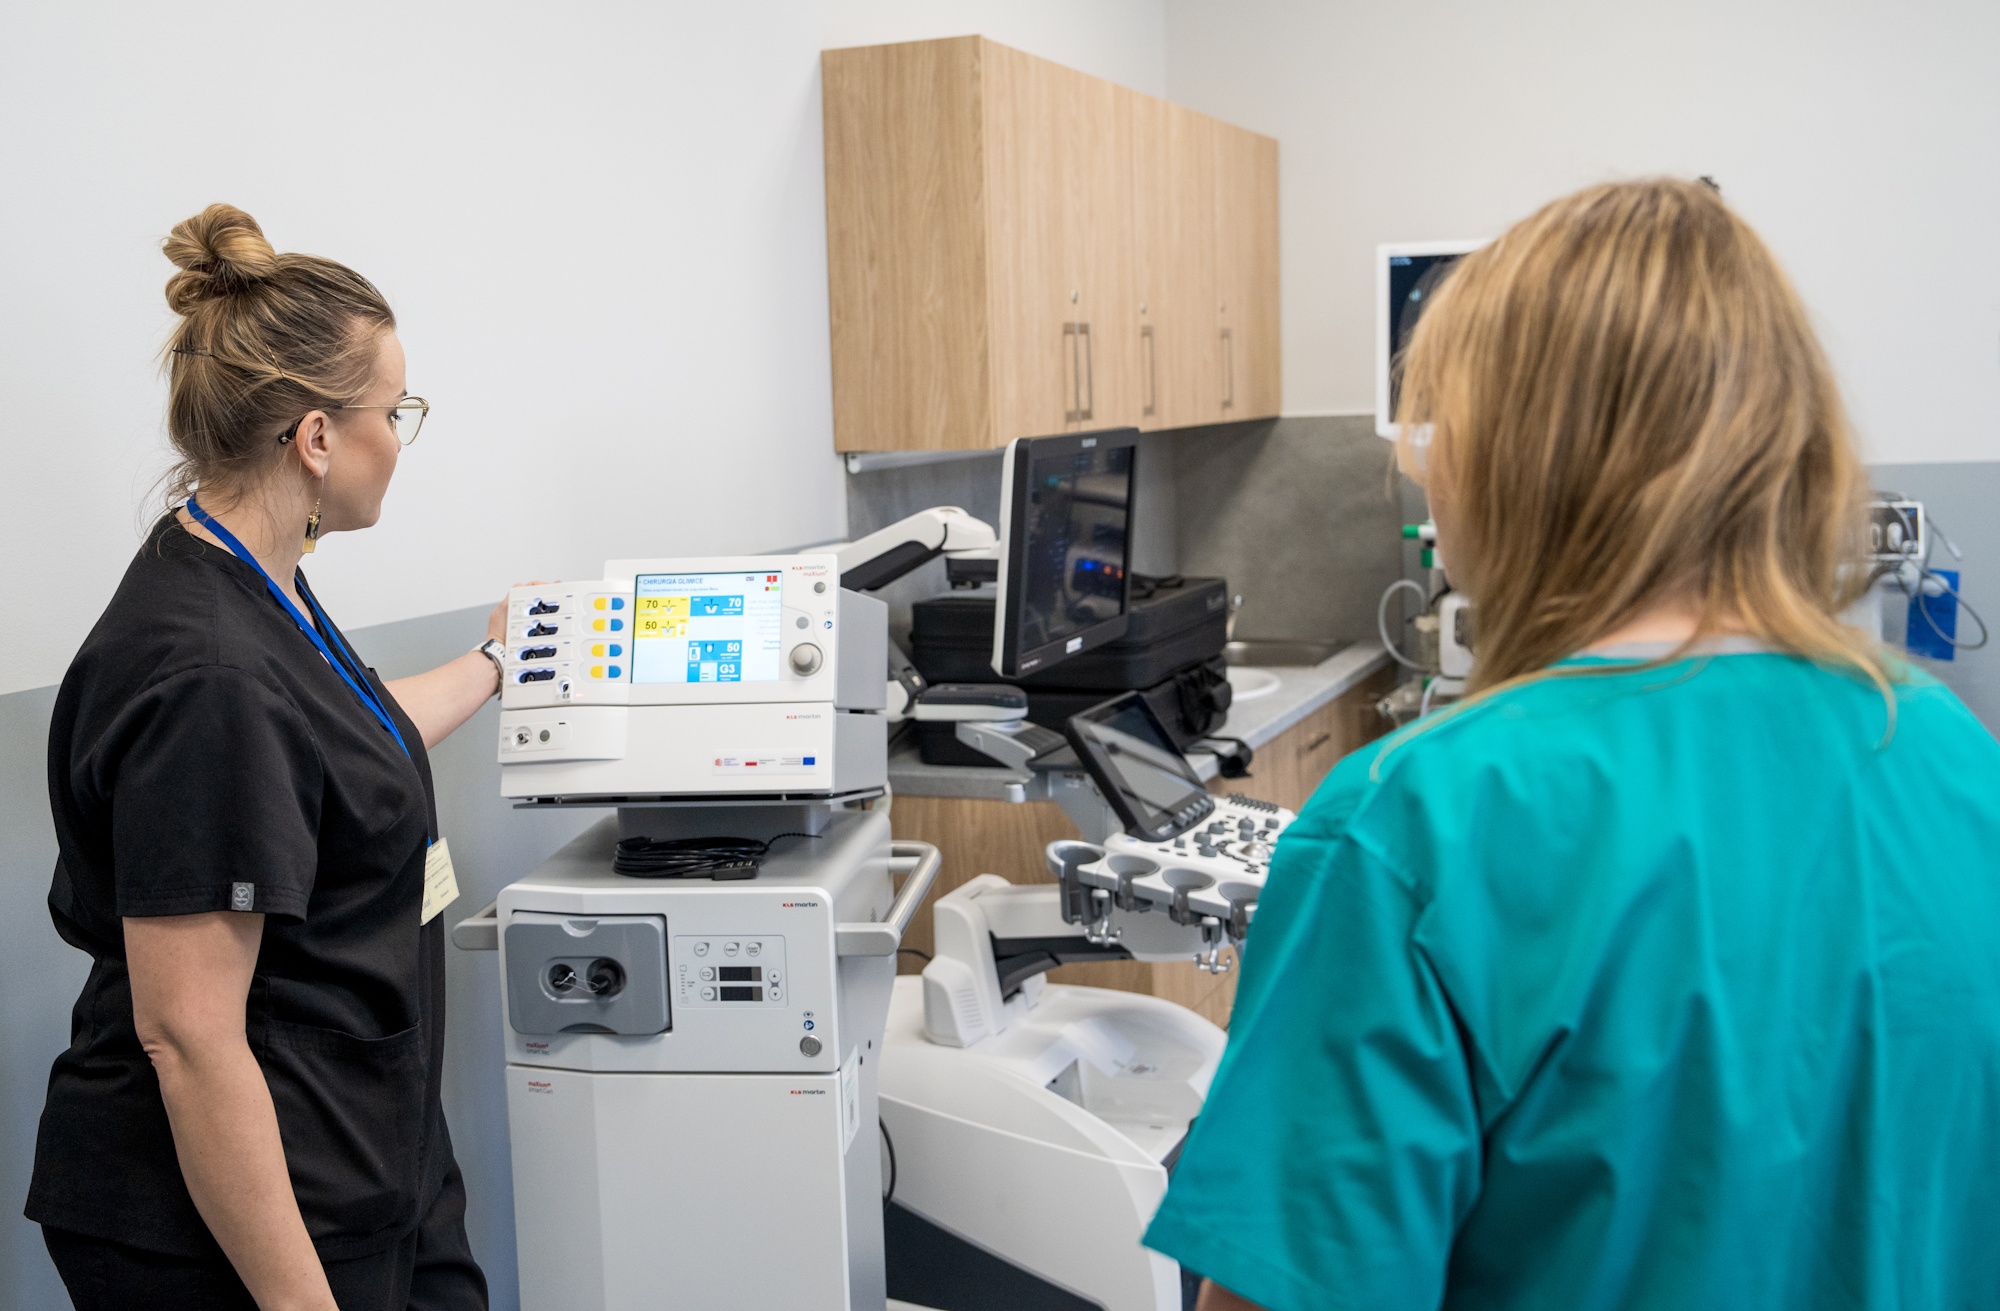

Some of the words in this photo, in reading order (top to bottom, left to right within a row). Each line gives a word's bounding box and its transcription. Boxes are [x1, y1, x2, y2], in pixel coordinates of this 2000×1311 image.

[678, 577, 703, 585] GLIWICE
[646, 600, 658, 609] 70
[728, 597, 742, 607] 70
[645, 621, 657, 630] 50
[727, 642, 740, 652] 50
[719, 664, 735, 674] G3
